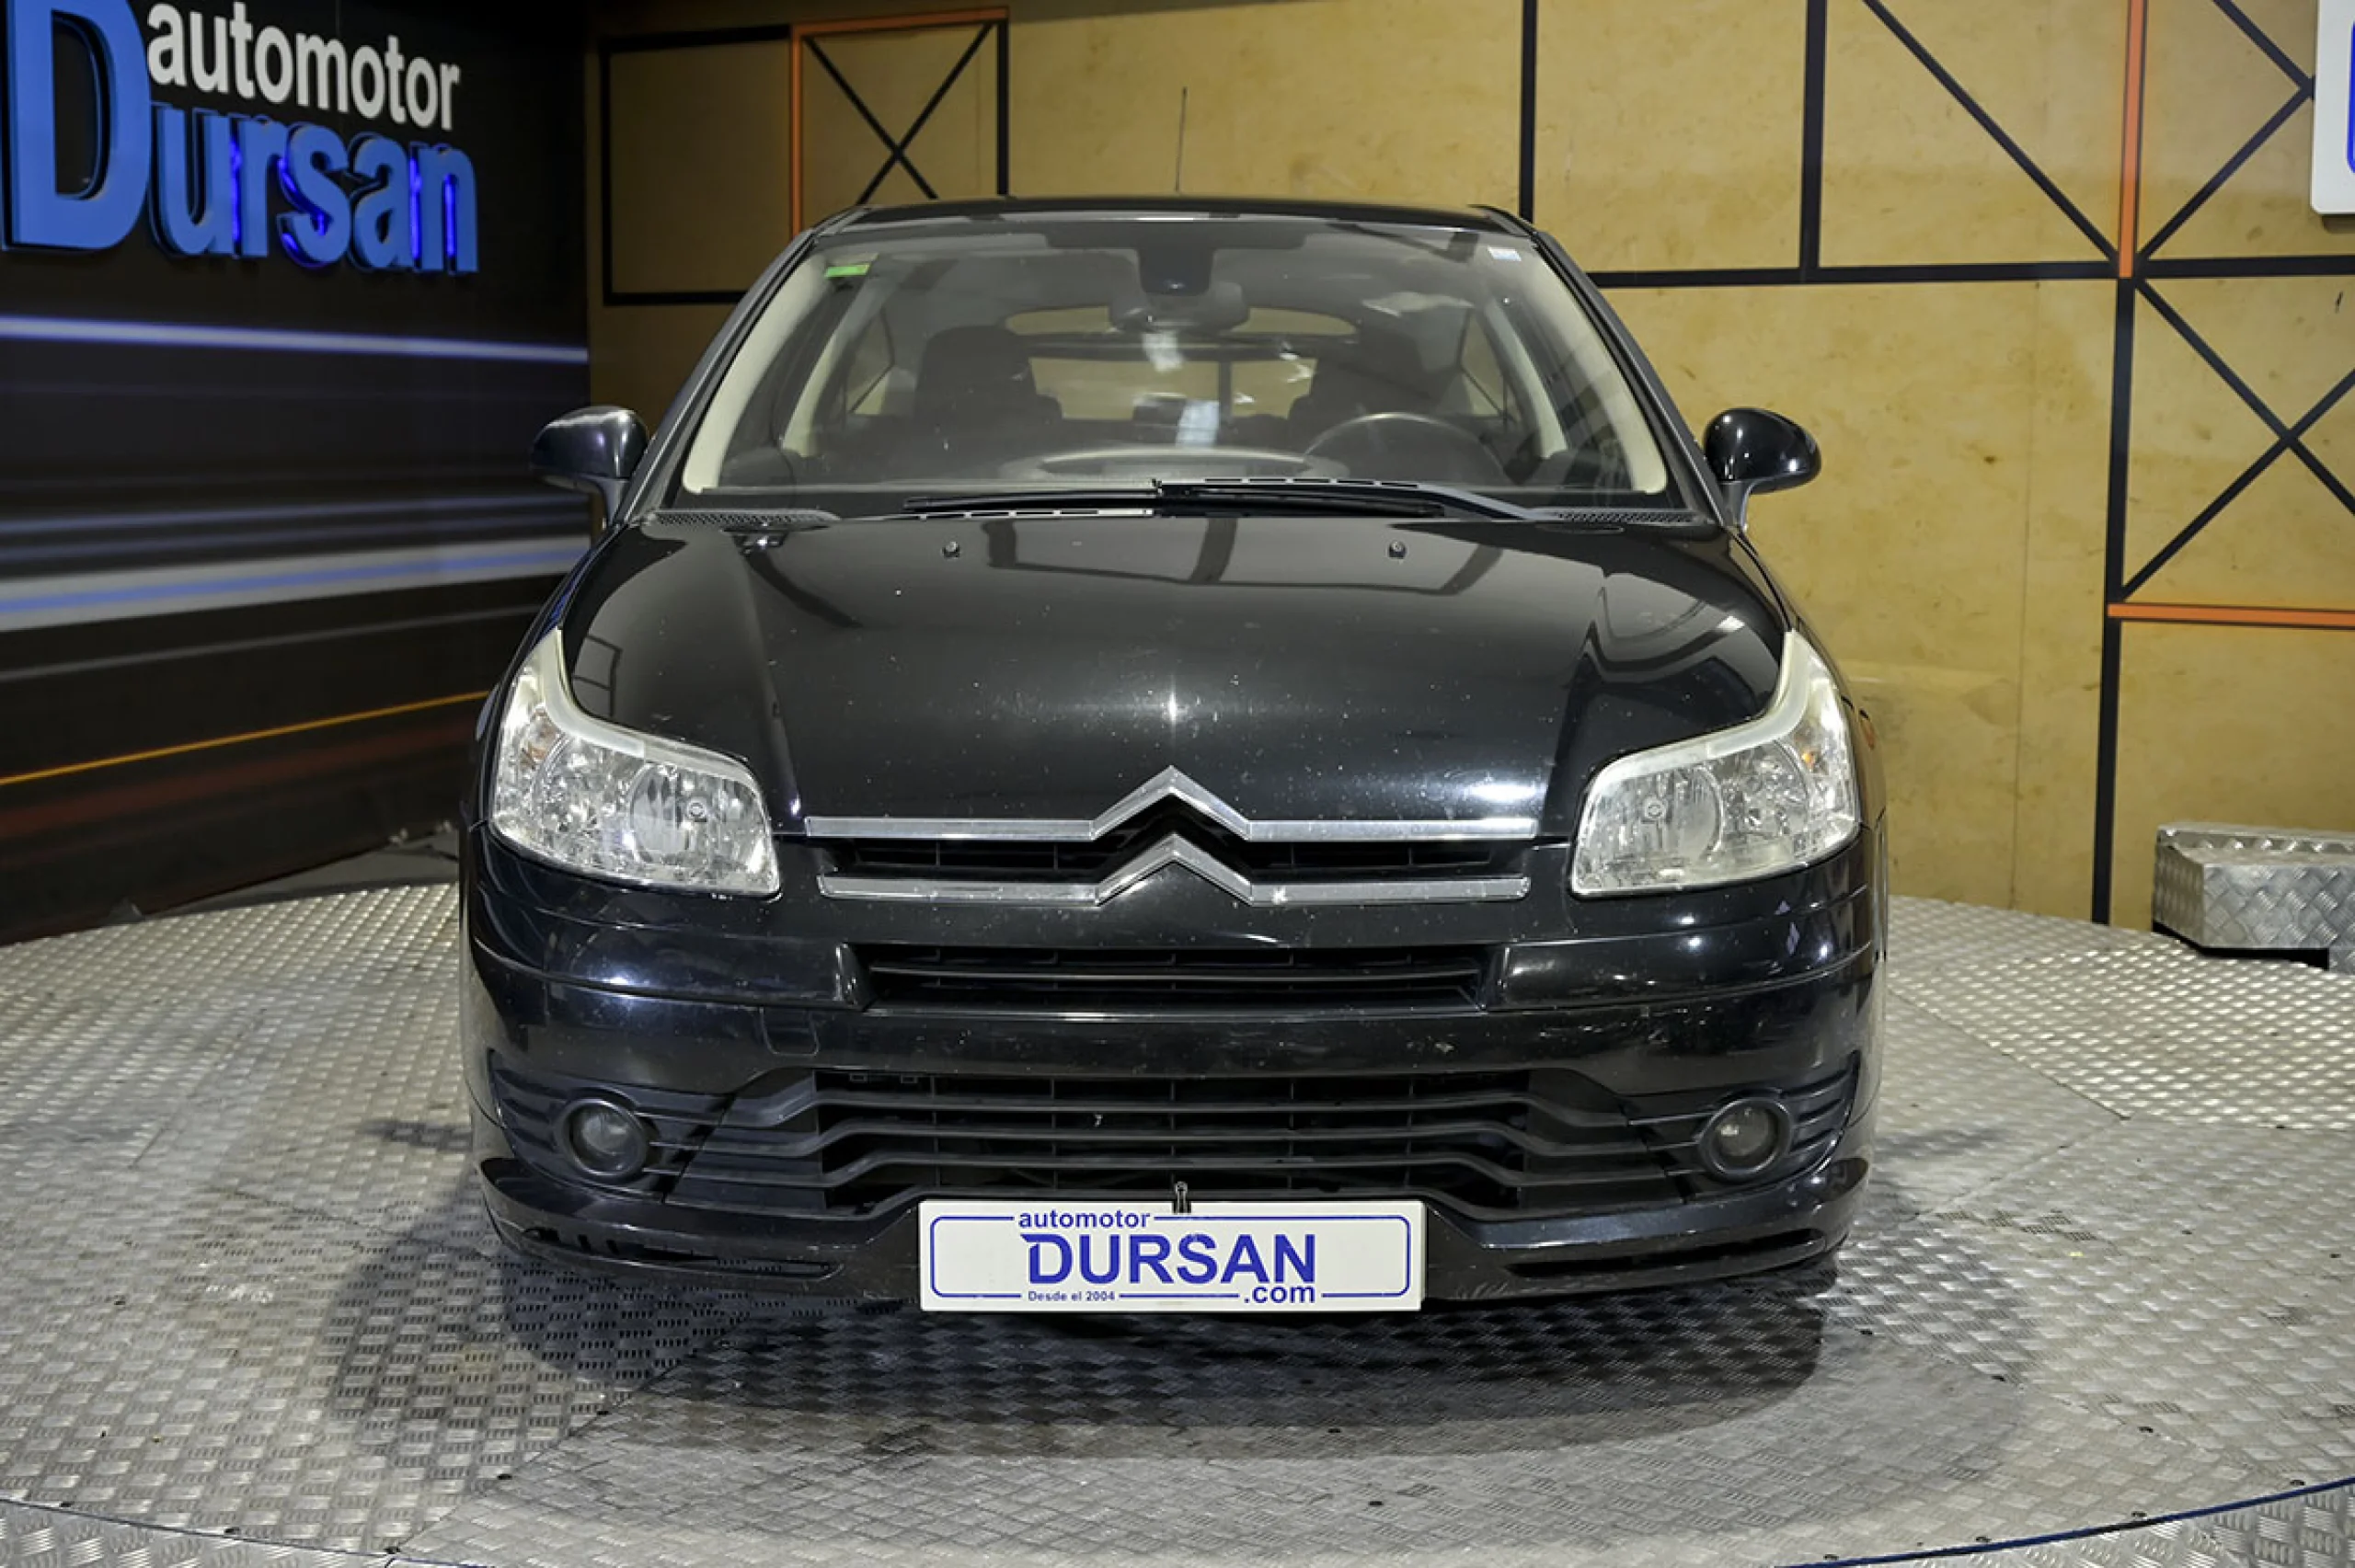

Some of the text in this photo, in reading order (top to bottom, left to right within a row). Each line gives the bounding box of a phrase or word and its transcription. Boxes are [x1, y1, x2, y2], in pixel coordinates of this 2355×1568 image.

[146, 2, 460, 130] automotor
[3, 0, 478, 273] Dursan
[1018, 1209, 1151, 1228] automotor
[1020, 1233, 1315, 1284] DURSAN
[1028, 1290, 1116, 1301] Desde el 2004
[1244, 1286, 1315, 1303] .com
